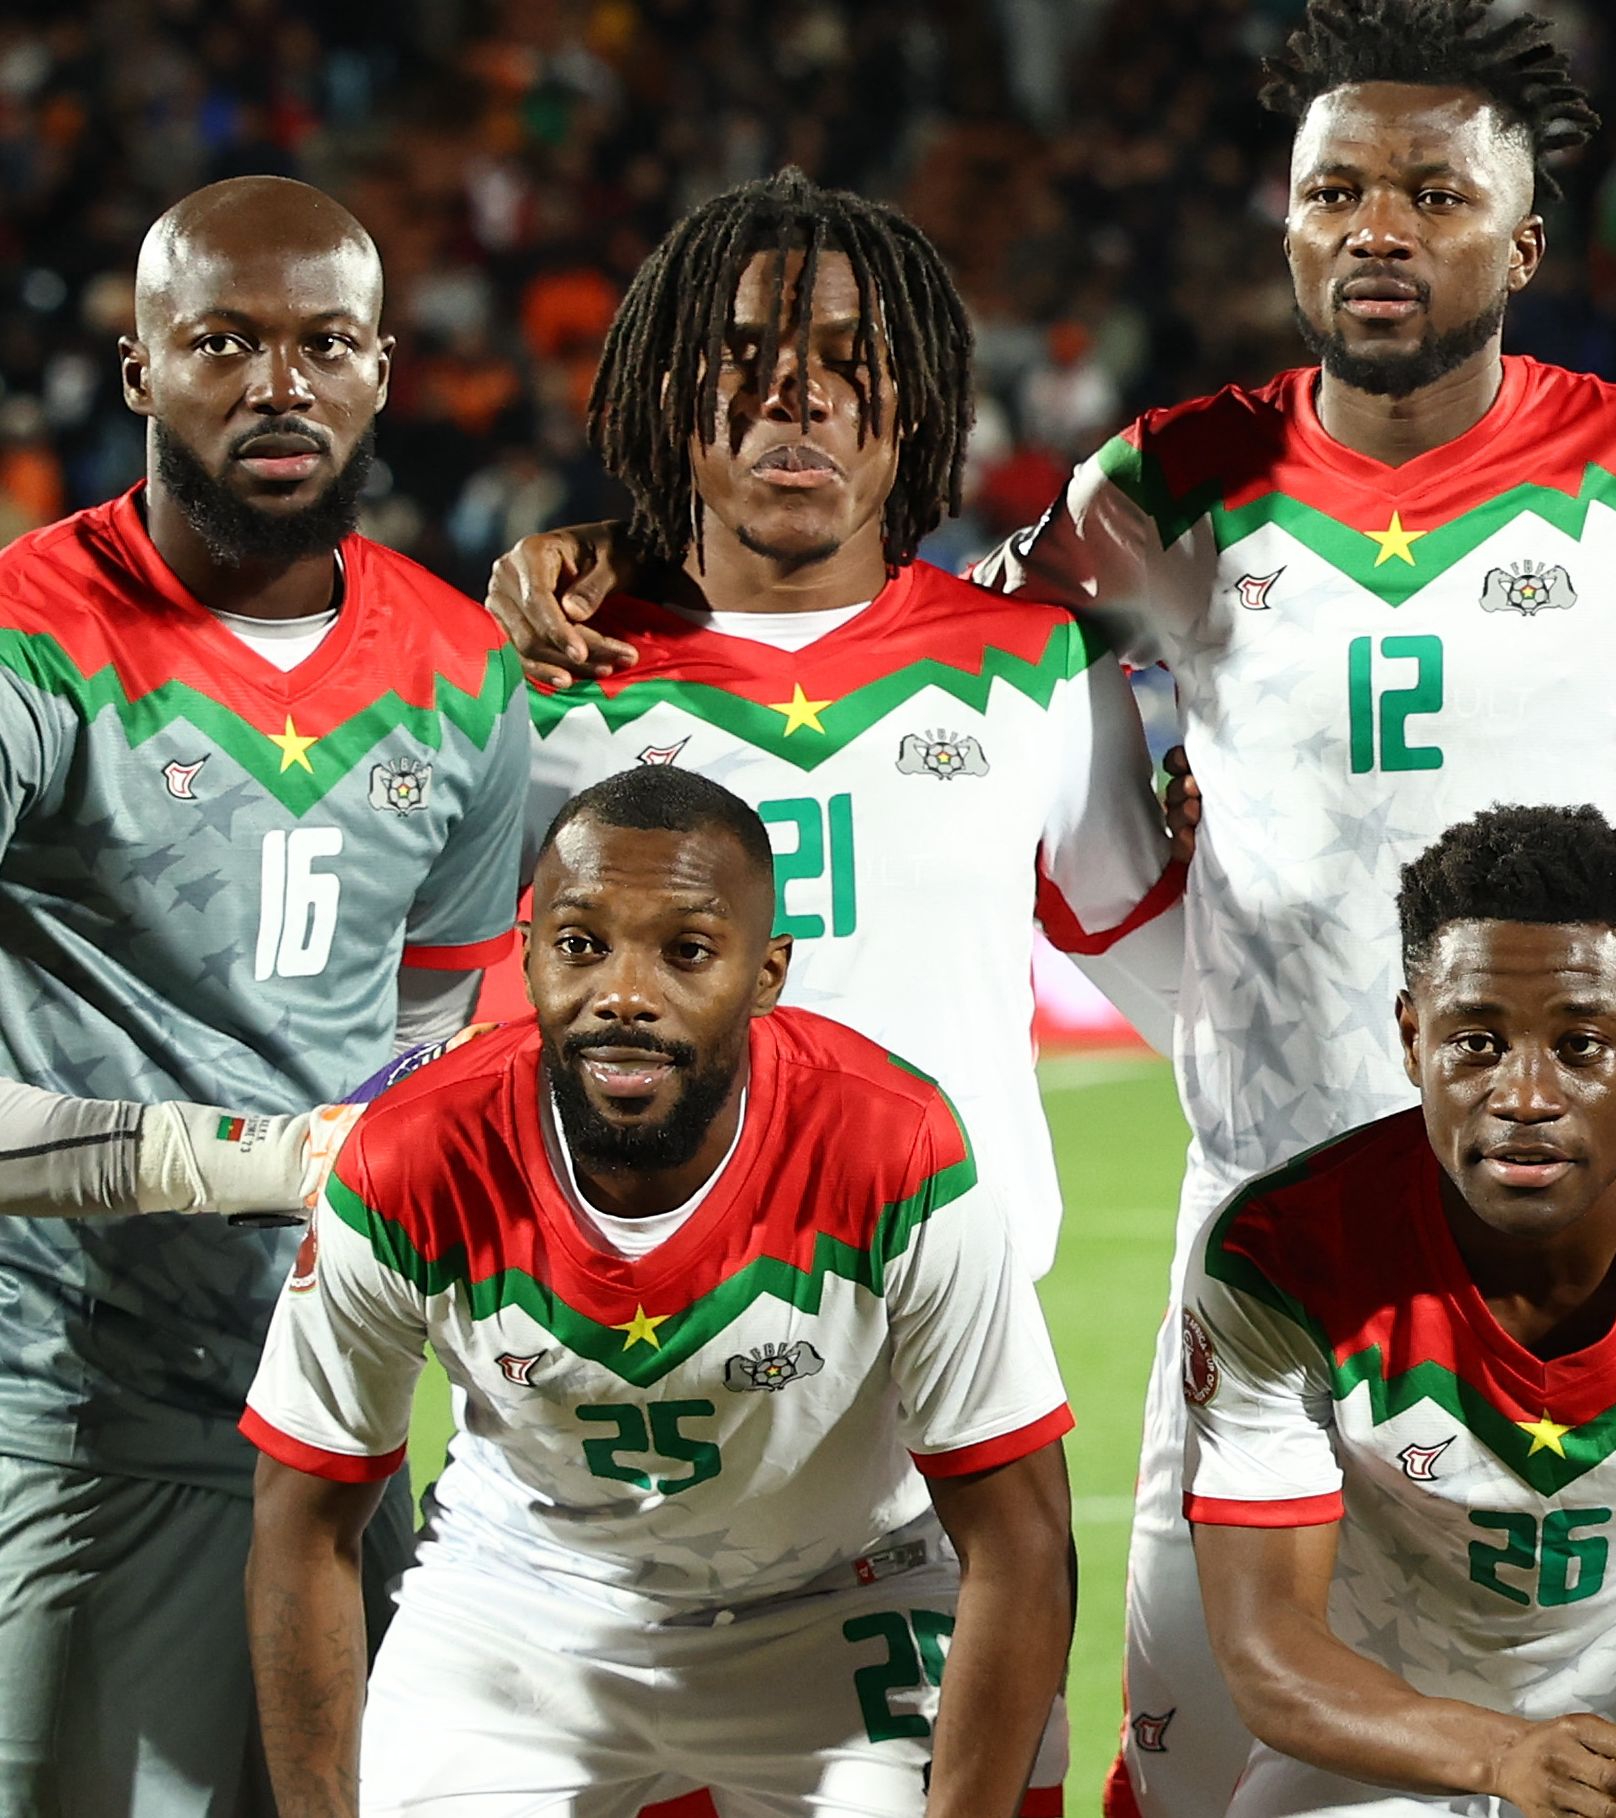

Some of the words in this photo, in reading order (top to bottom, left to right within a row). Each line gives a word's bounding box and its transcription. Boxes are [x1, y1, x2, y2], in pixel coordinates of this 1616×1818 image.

[1348, 635, 1444, 774] 12
[255, 827, 343, 982] 16
[757, 793, 857, 940] 21
[575, 1399, 721, 1495] 25
[1468, 1507, 1612, 1607] 26
